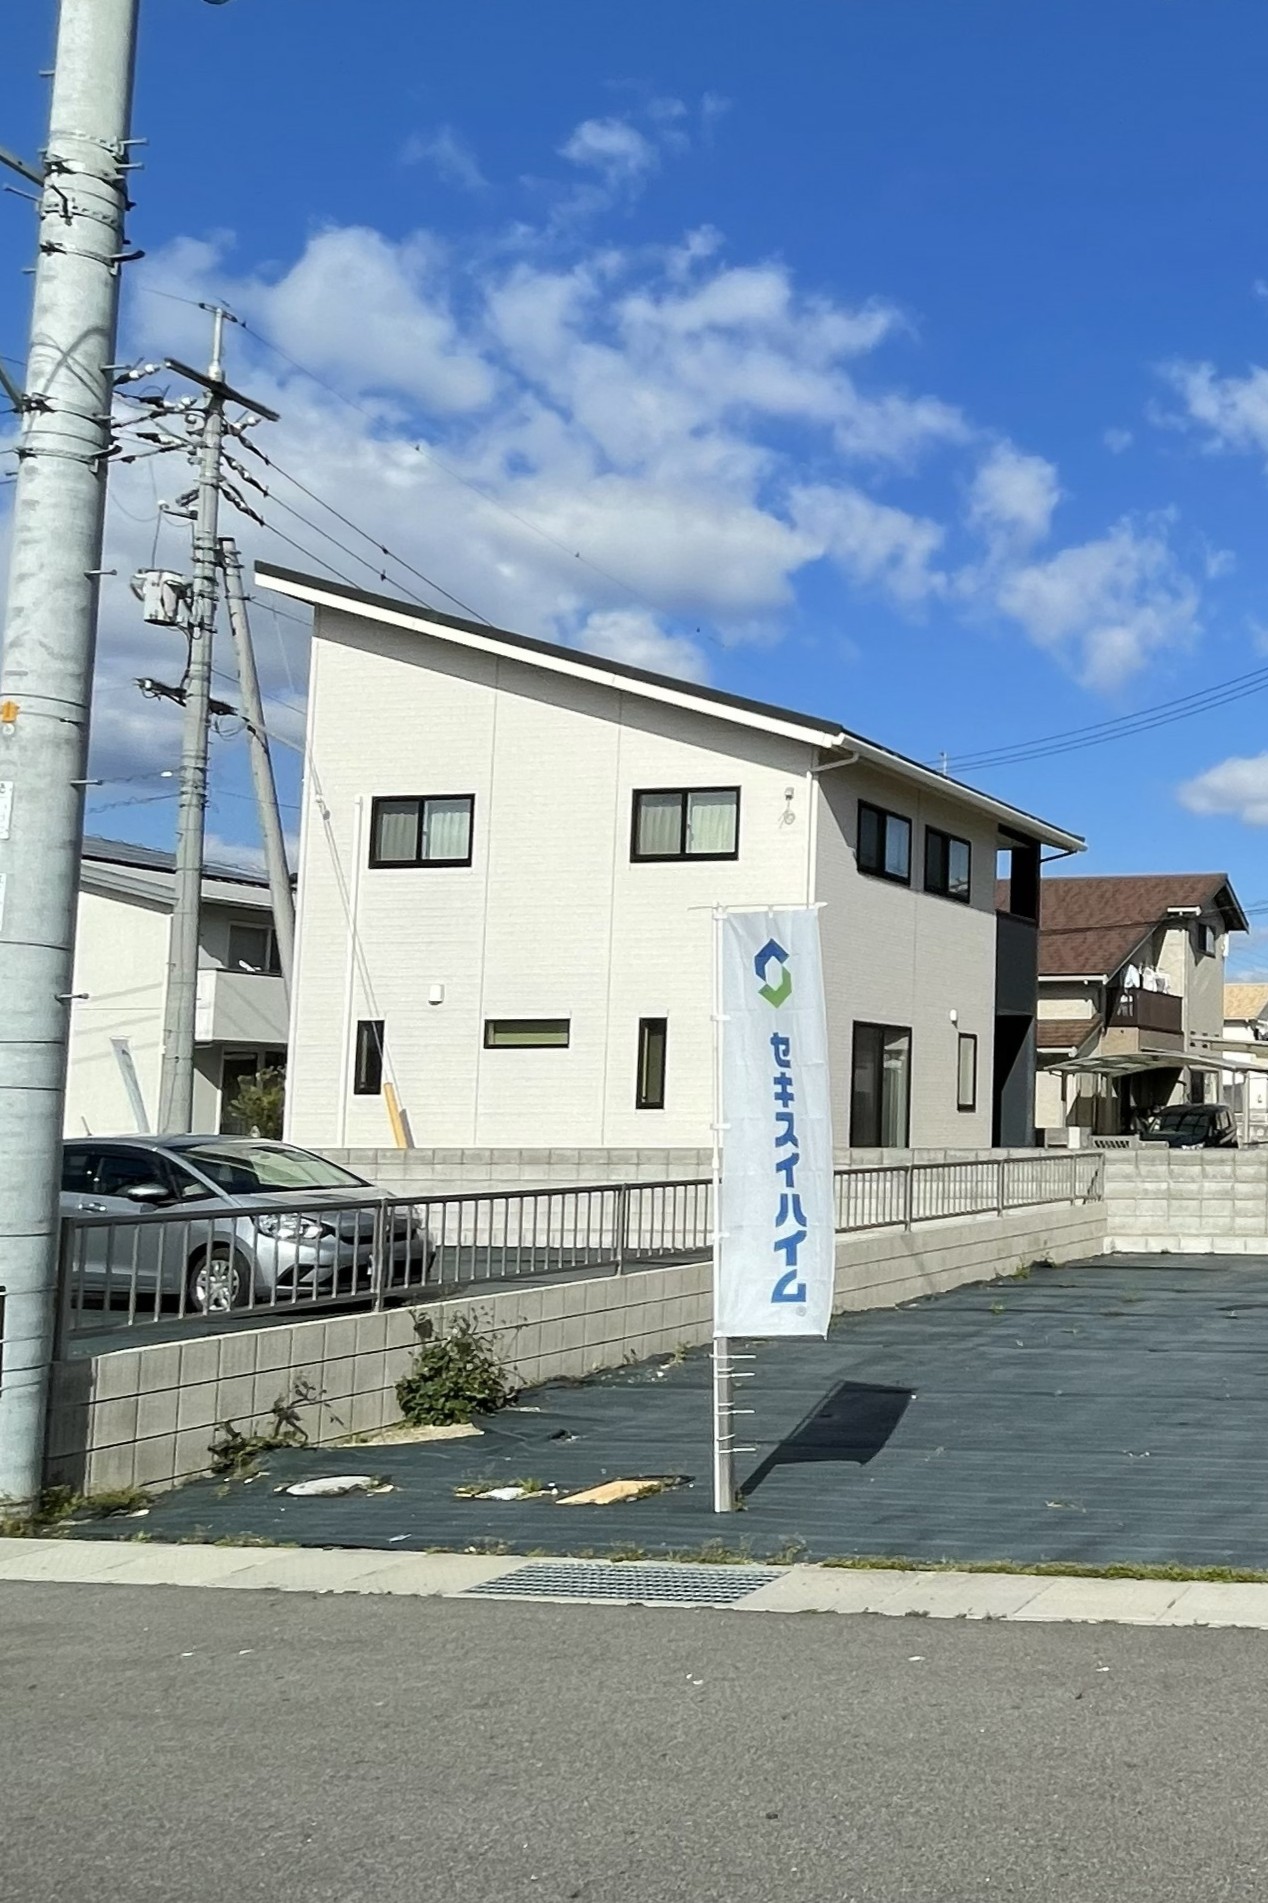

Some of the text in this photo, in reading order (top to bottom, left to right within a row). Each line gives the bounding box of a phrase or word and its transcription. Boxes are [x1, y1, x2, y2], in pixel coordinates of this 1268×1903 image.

[770, 1032, 807, 1303] セキスイハイム
